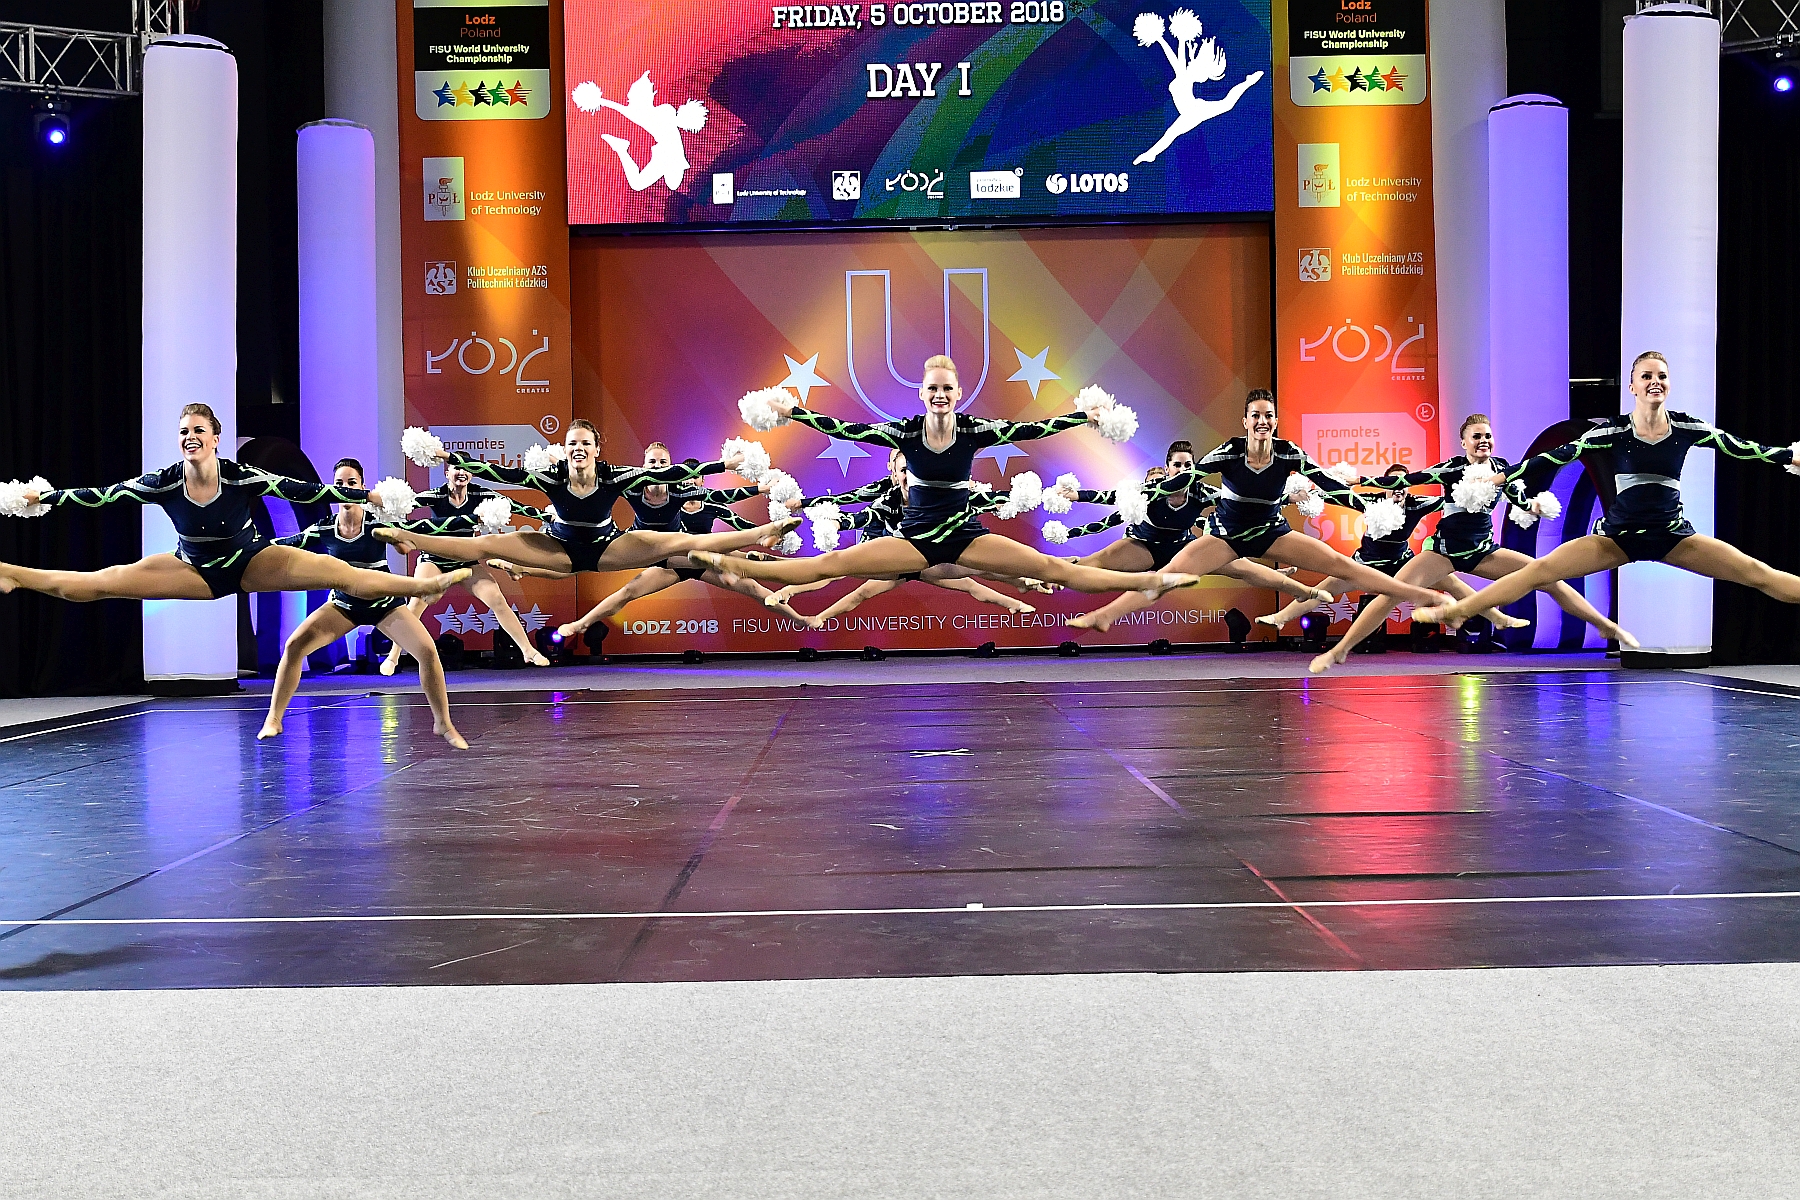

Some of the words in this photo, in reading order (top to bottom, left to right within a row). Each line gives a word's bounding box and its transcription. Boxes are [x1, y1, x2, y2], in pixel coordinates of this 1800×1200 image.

[1341, 0, 1372, 10] Lodz
[465, 14, 496, 25] Lodz
[771, 5, 862, 30] FRIDAY,
[869, 4, 886, 26] 5
[893, 2, 1003, 25] OCTOBER
[1010, 0, 1066, 23] 2018
[1335, 12, 1377, 23] Poland
[460, 27, 501, 38] Poland
[1303, 30, 1327, 39] FISU
[1328, 30, 1357, 39] World
[1358, 29, 1406, 39] University
[429, 45, 452, 54] FISU
[453, 44, 481, 53] World
[482, 44, 530, 54] University
[1321, 39, 1389, 50] Championship
[446, 54, 513, 64] Championship
[866, 62, 942, 98] DAY
[957, 61, 972, 96] I
[1070, 172, 1129, 193] LOTOS
[1346, 177, 1370, 187] Lodz
[1372, 176, 1422, 188] University
[470, 191, 495, 201] Lodz
[496, 190, 546, 201] University
[1346, 191, 1357, 202] of
[1359, 191, 1418, 202] Technology
[471, 205, 483, 215] of
[484, 205, 542, 216] Technology
[1342, 253, 1361, 264] Klub
[1362, 253, 1406, 264] Uczelniany
[1406, 252, 1423, 262] AZS
[467, 266, 486, 277] Klub
[487, 266, 531, 278] Uczelniany
[531, 265, 547, 275] AZS
[1342, 265, 1389, 276] Politechniki
[1390, 264, 1424, 276] Łódzkiej
[467, 278, 514, 289] Politechniki
[515, 277, 548, 289] Łódzkiej
[1317, 426, 1380, 441] promotes
[443, 437, 505, 452] promotes
[1317, 441, 1413, 466] lodzkie
[623, 620, 671, 635] LODZ
[676, 619, 719, 634] 2018
[732, 618, 771, 634] FISU
[845, 614, 947, 631] UNIVERSITY
